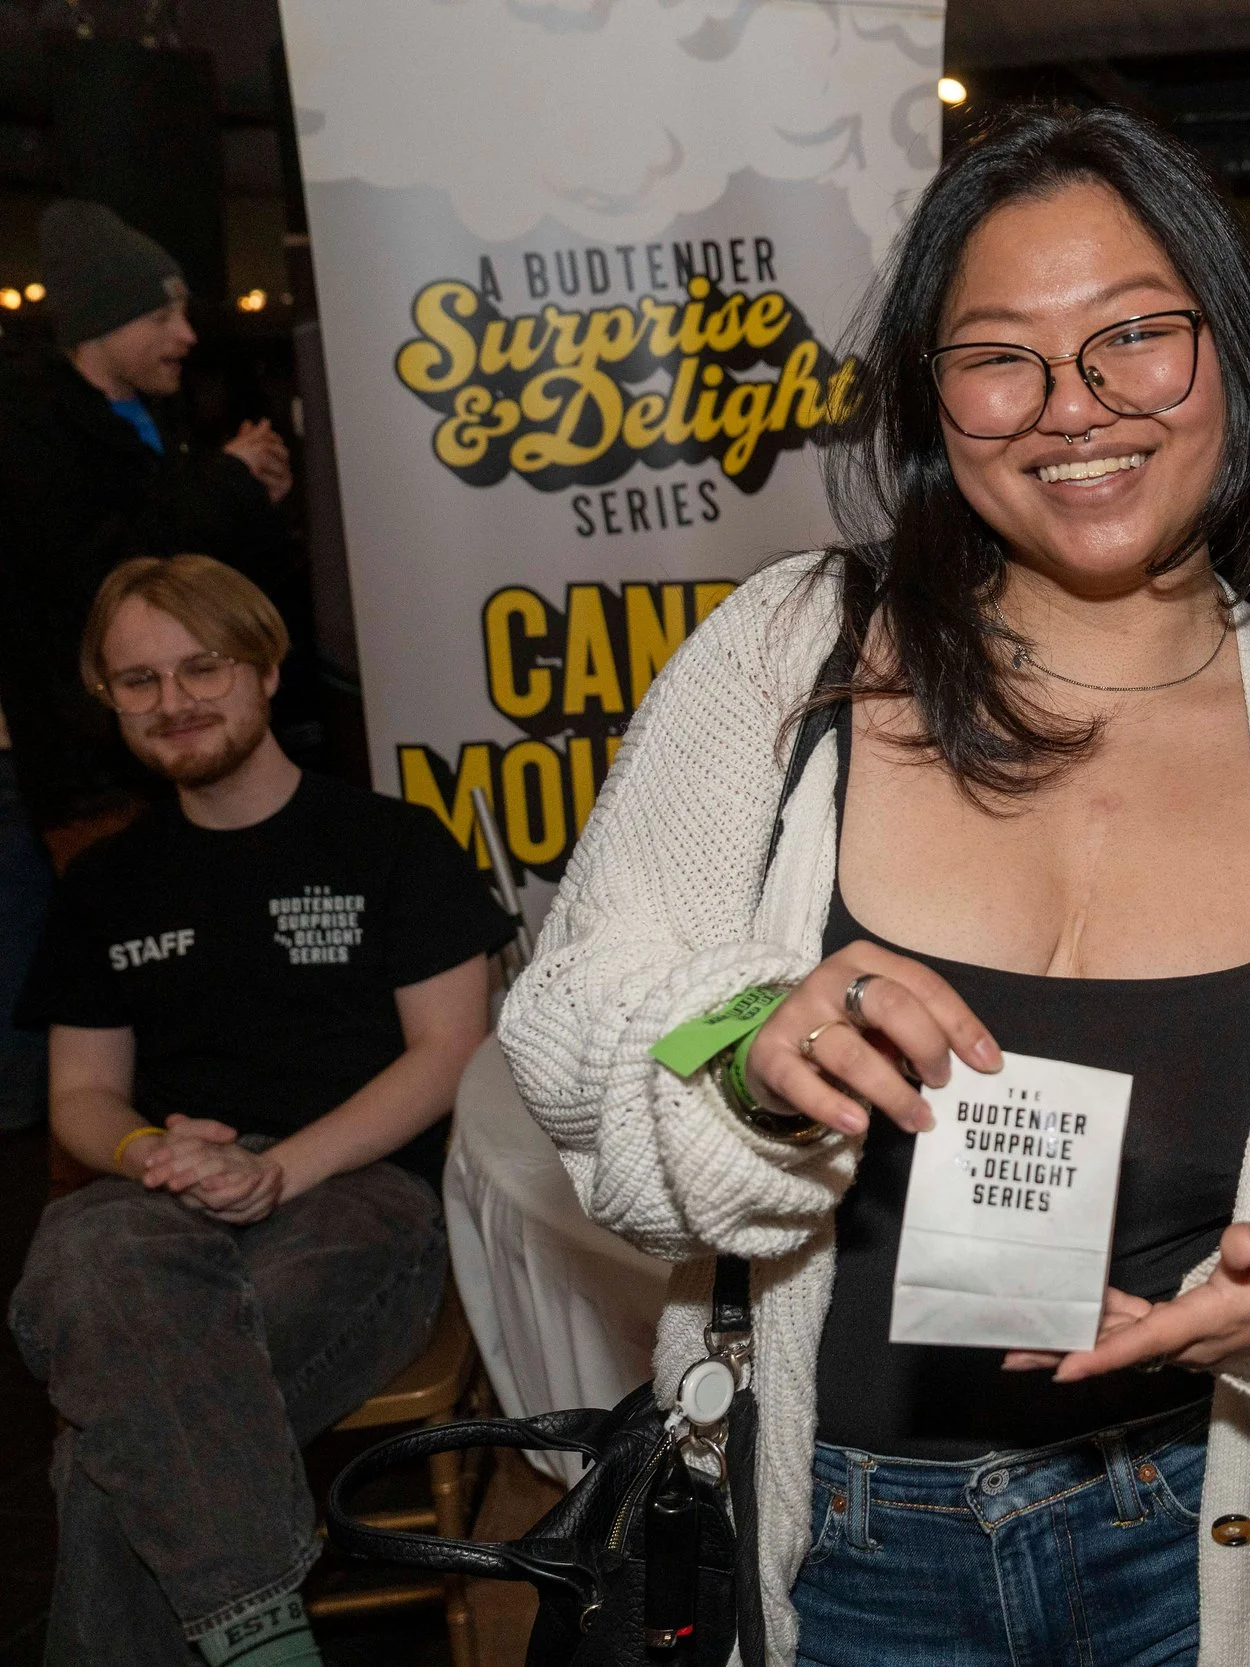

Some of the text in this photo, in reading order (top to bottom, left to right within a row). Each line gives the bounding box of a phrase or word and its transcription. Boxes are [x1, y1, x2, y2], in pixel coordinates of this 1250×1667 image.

[478, 236, 778, 302] A BUDTENDER
[396, 275, 792, 393] Surprise
[433, 340, 864, 476] & Delight
[571, 480, 721, 538] SERIES
[108, 928, 196, 971] STAFF
[957, 1101, 1087, 1135] BUDTENDER
[965, 1129, 1075, 1161] SURPRISE
[984, 1157, 1078, 1189] DELIGHT
[972, 1184, 1051, 1212] SERIES
[224, 1606, 282, 1647] EST
